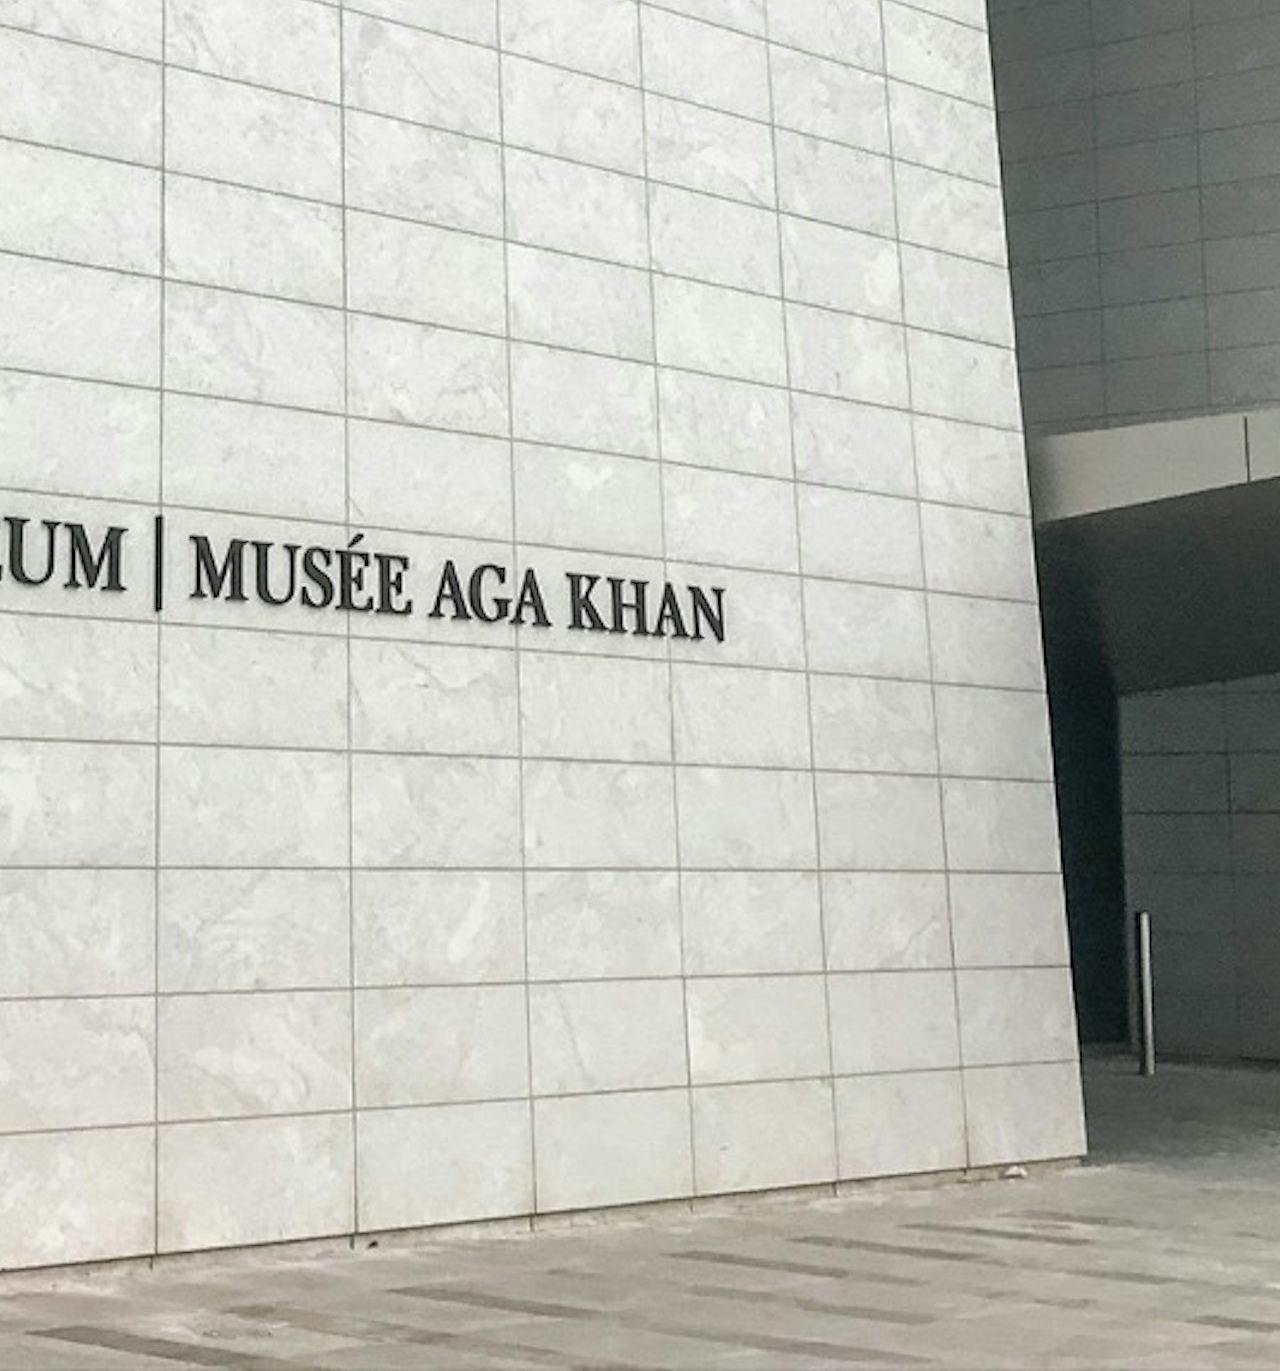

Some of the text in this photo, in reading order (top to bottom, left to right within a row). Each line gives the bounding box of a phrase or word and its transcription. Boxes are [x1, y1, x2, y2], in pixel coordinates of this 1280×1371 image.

[188, 532, 413, 617] MUSÉE
[428, 560, 552, 628] AGA
[565, 572, 726, 643] KHAN
